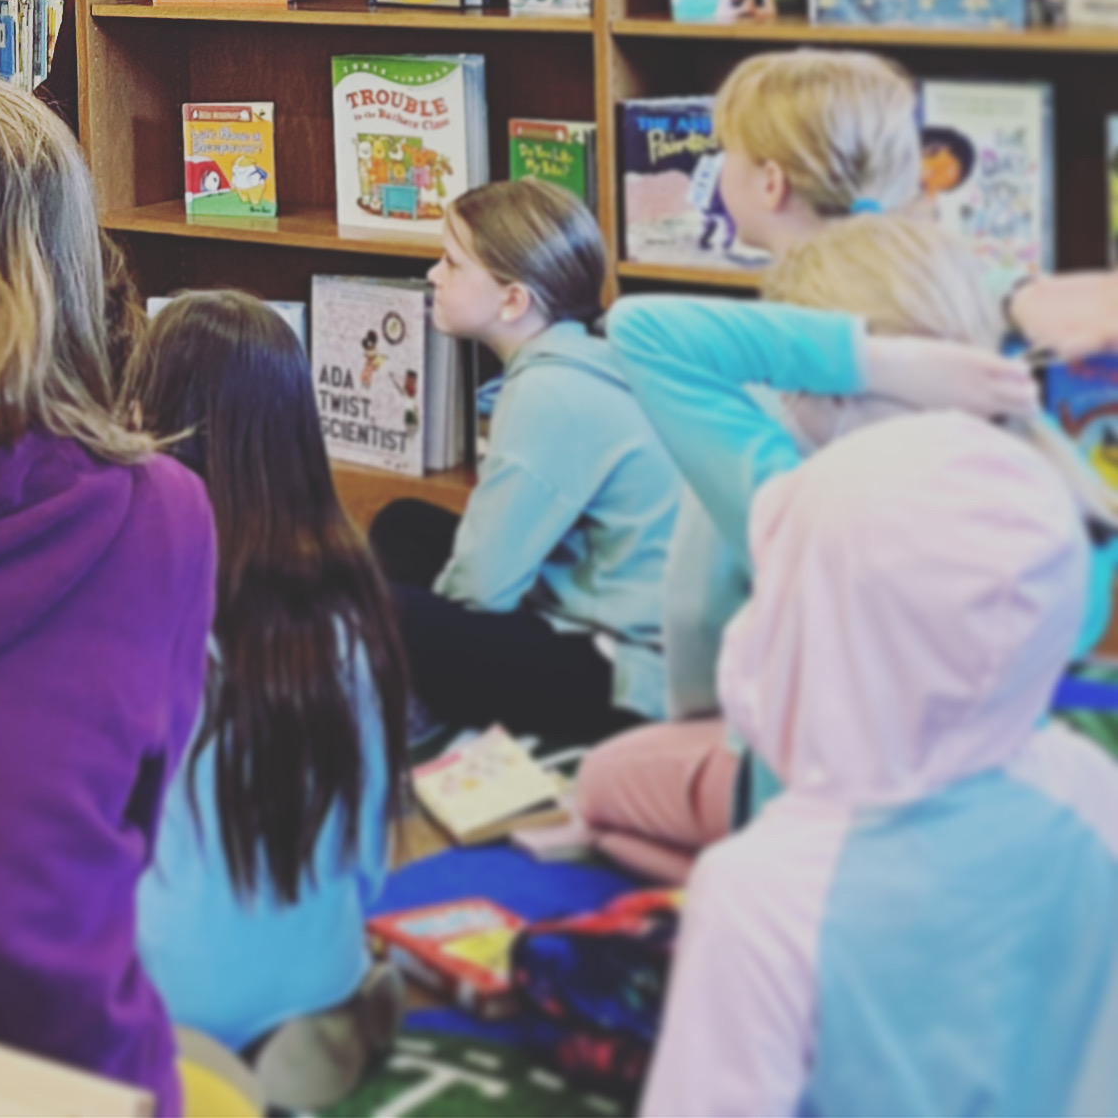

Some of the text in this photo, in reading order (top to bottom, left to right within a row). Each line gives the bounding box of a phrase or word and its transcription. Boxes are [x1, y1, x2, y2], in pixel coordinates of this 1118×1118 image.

[346, 89, 449, 118] TROUBLE
[319, 364, 355, 390] ADA
[319, 390, 375, 424] TWIST,
[319, 416, 409, 453] SCIENTIST
